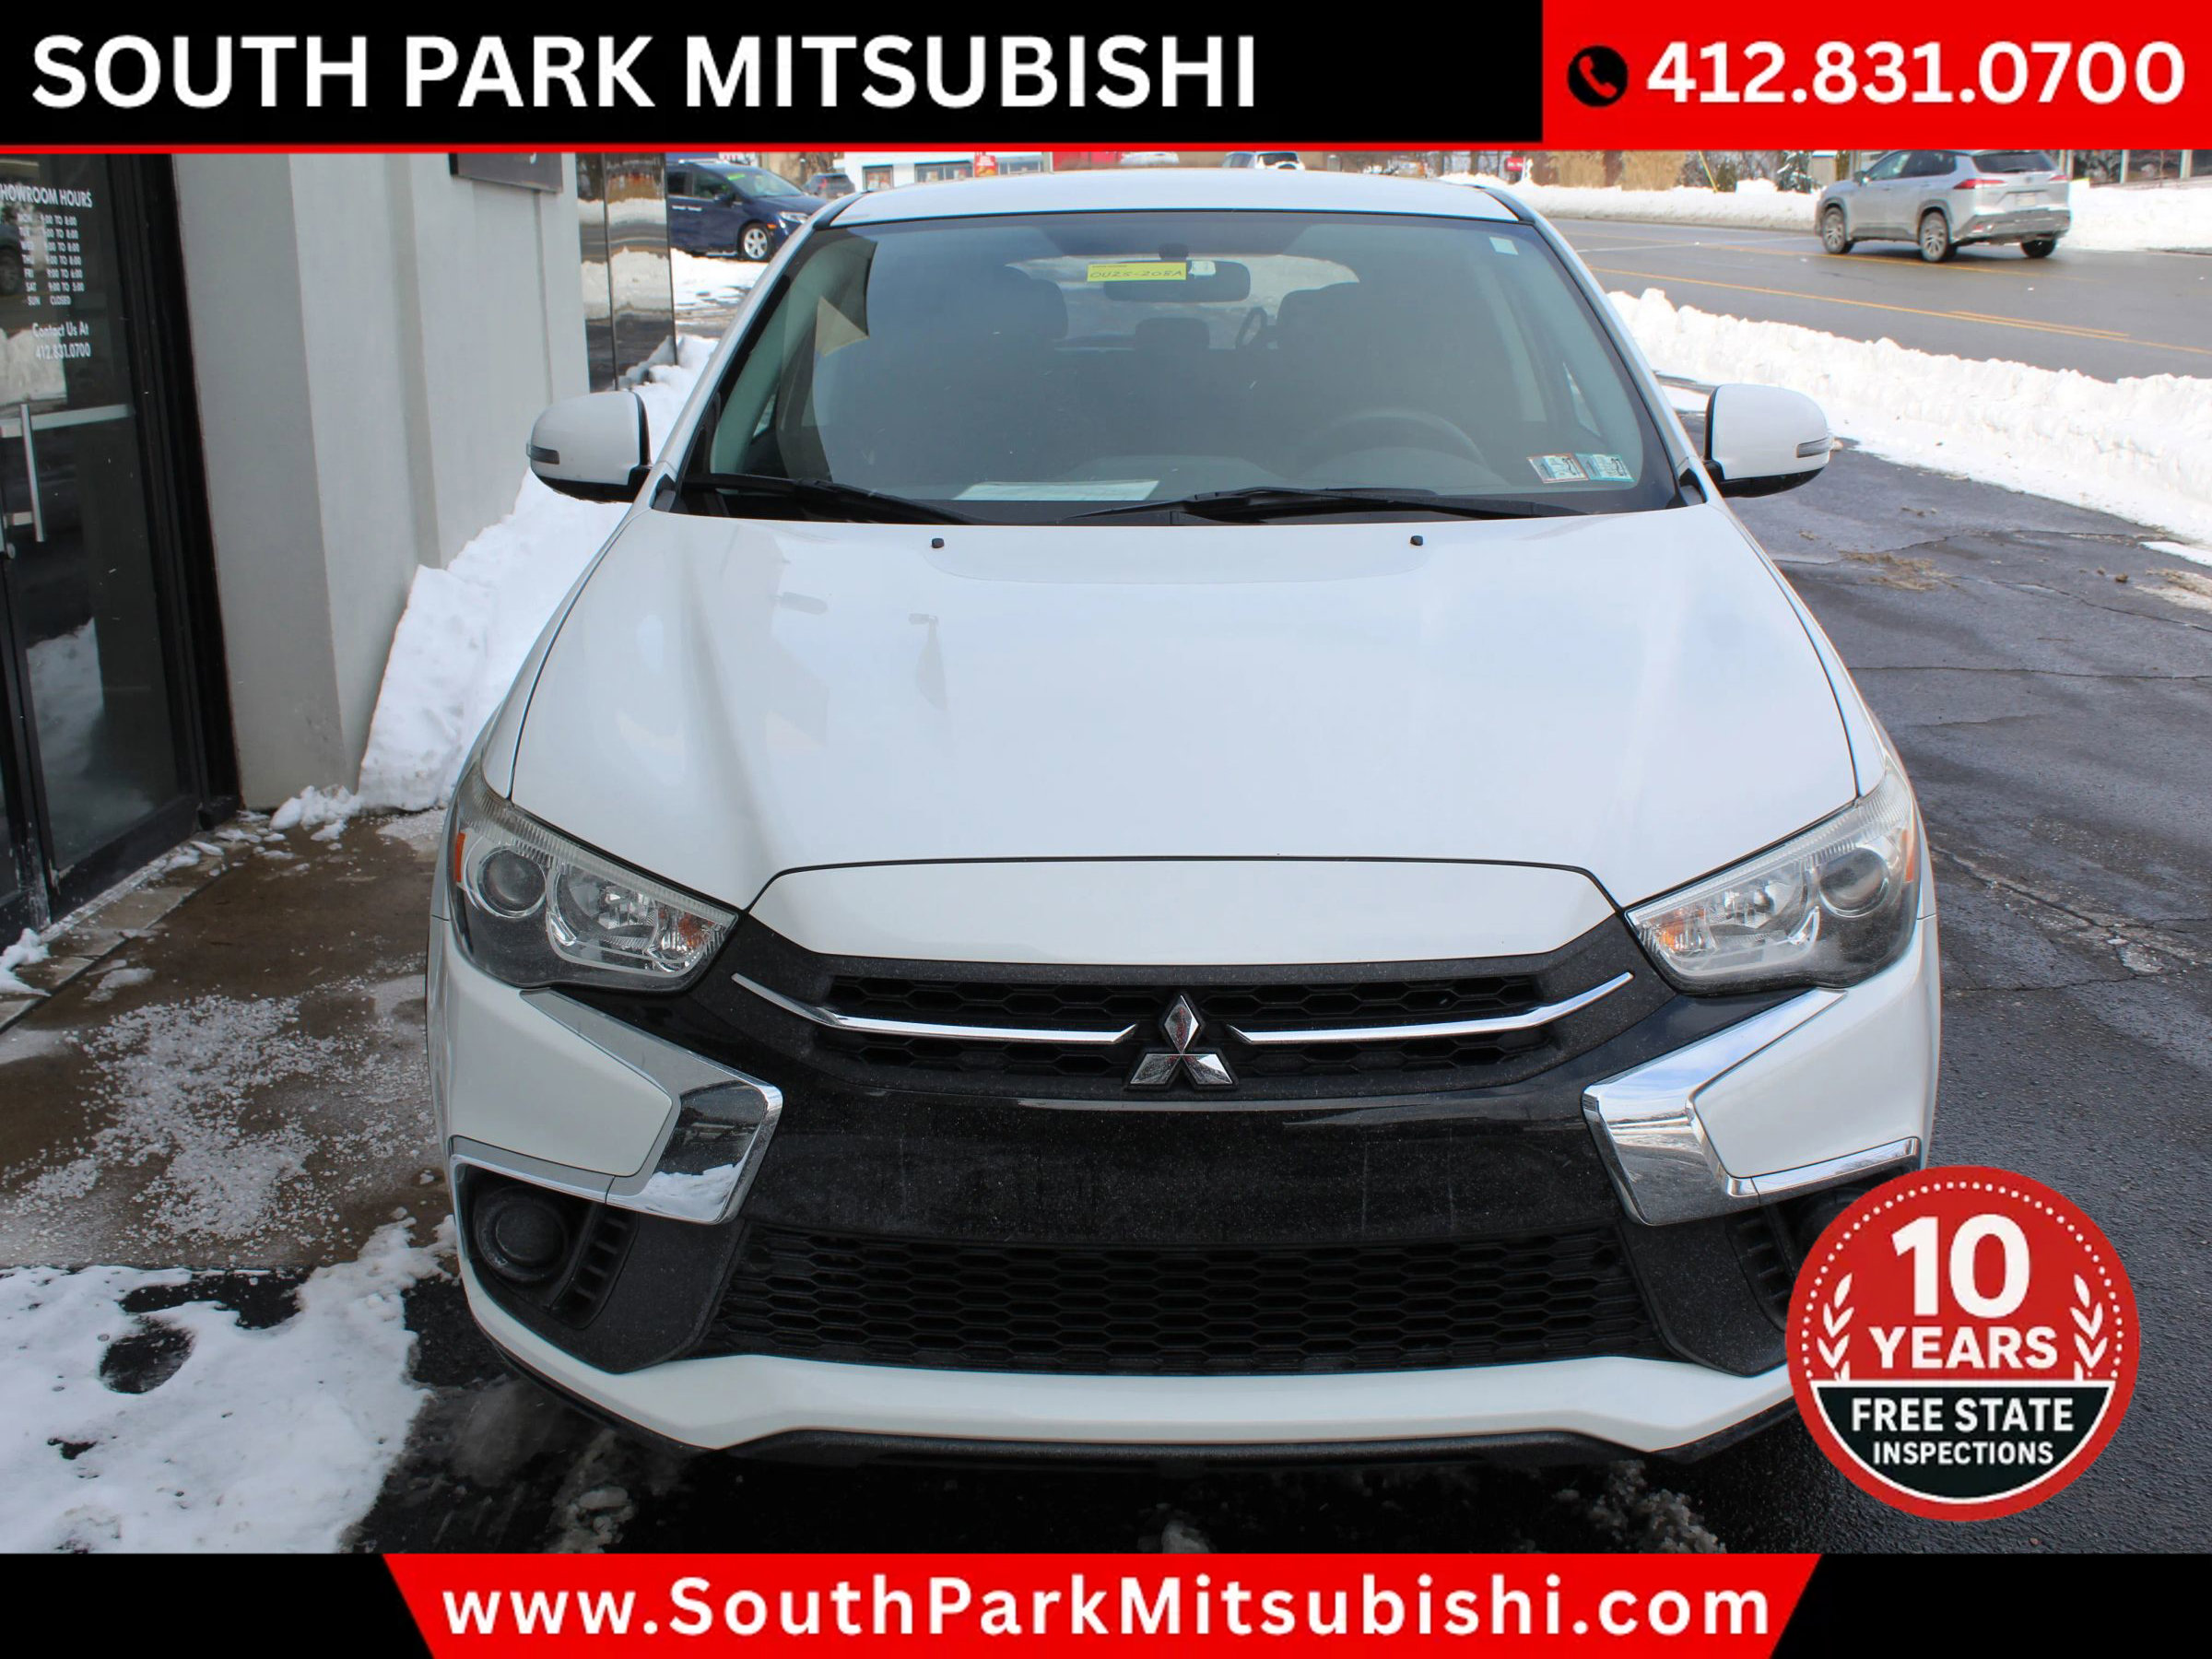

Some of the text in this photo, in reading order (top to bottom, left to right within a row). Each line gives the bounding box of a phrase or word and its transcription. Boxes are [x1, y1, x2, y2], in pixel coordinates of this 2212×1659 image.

[59, 189, 93, 208] HOURS
[54, 215, 64, 225] TO
[55, 229, 65, 239] TO
[57, 241, 66, 252] TO
[59, 254, 67, 265] TO
[24, 268, 34, 278] FRI
[60, 268, 69, 278] TO
[26, 282, 37, 292] SAT
[61, 282, 70, 292] TO
[28, 295, 71, 306] SUN CLOSED
[32, 321, 88, 338] Contact Us At
[36, 343, 91, 359] 412.831.0700
